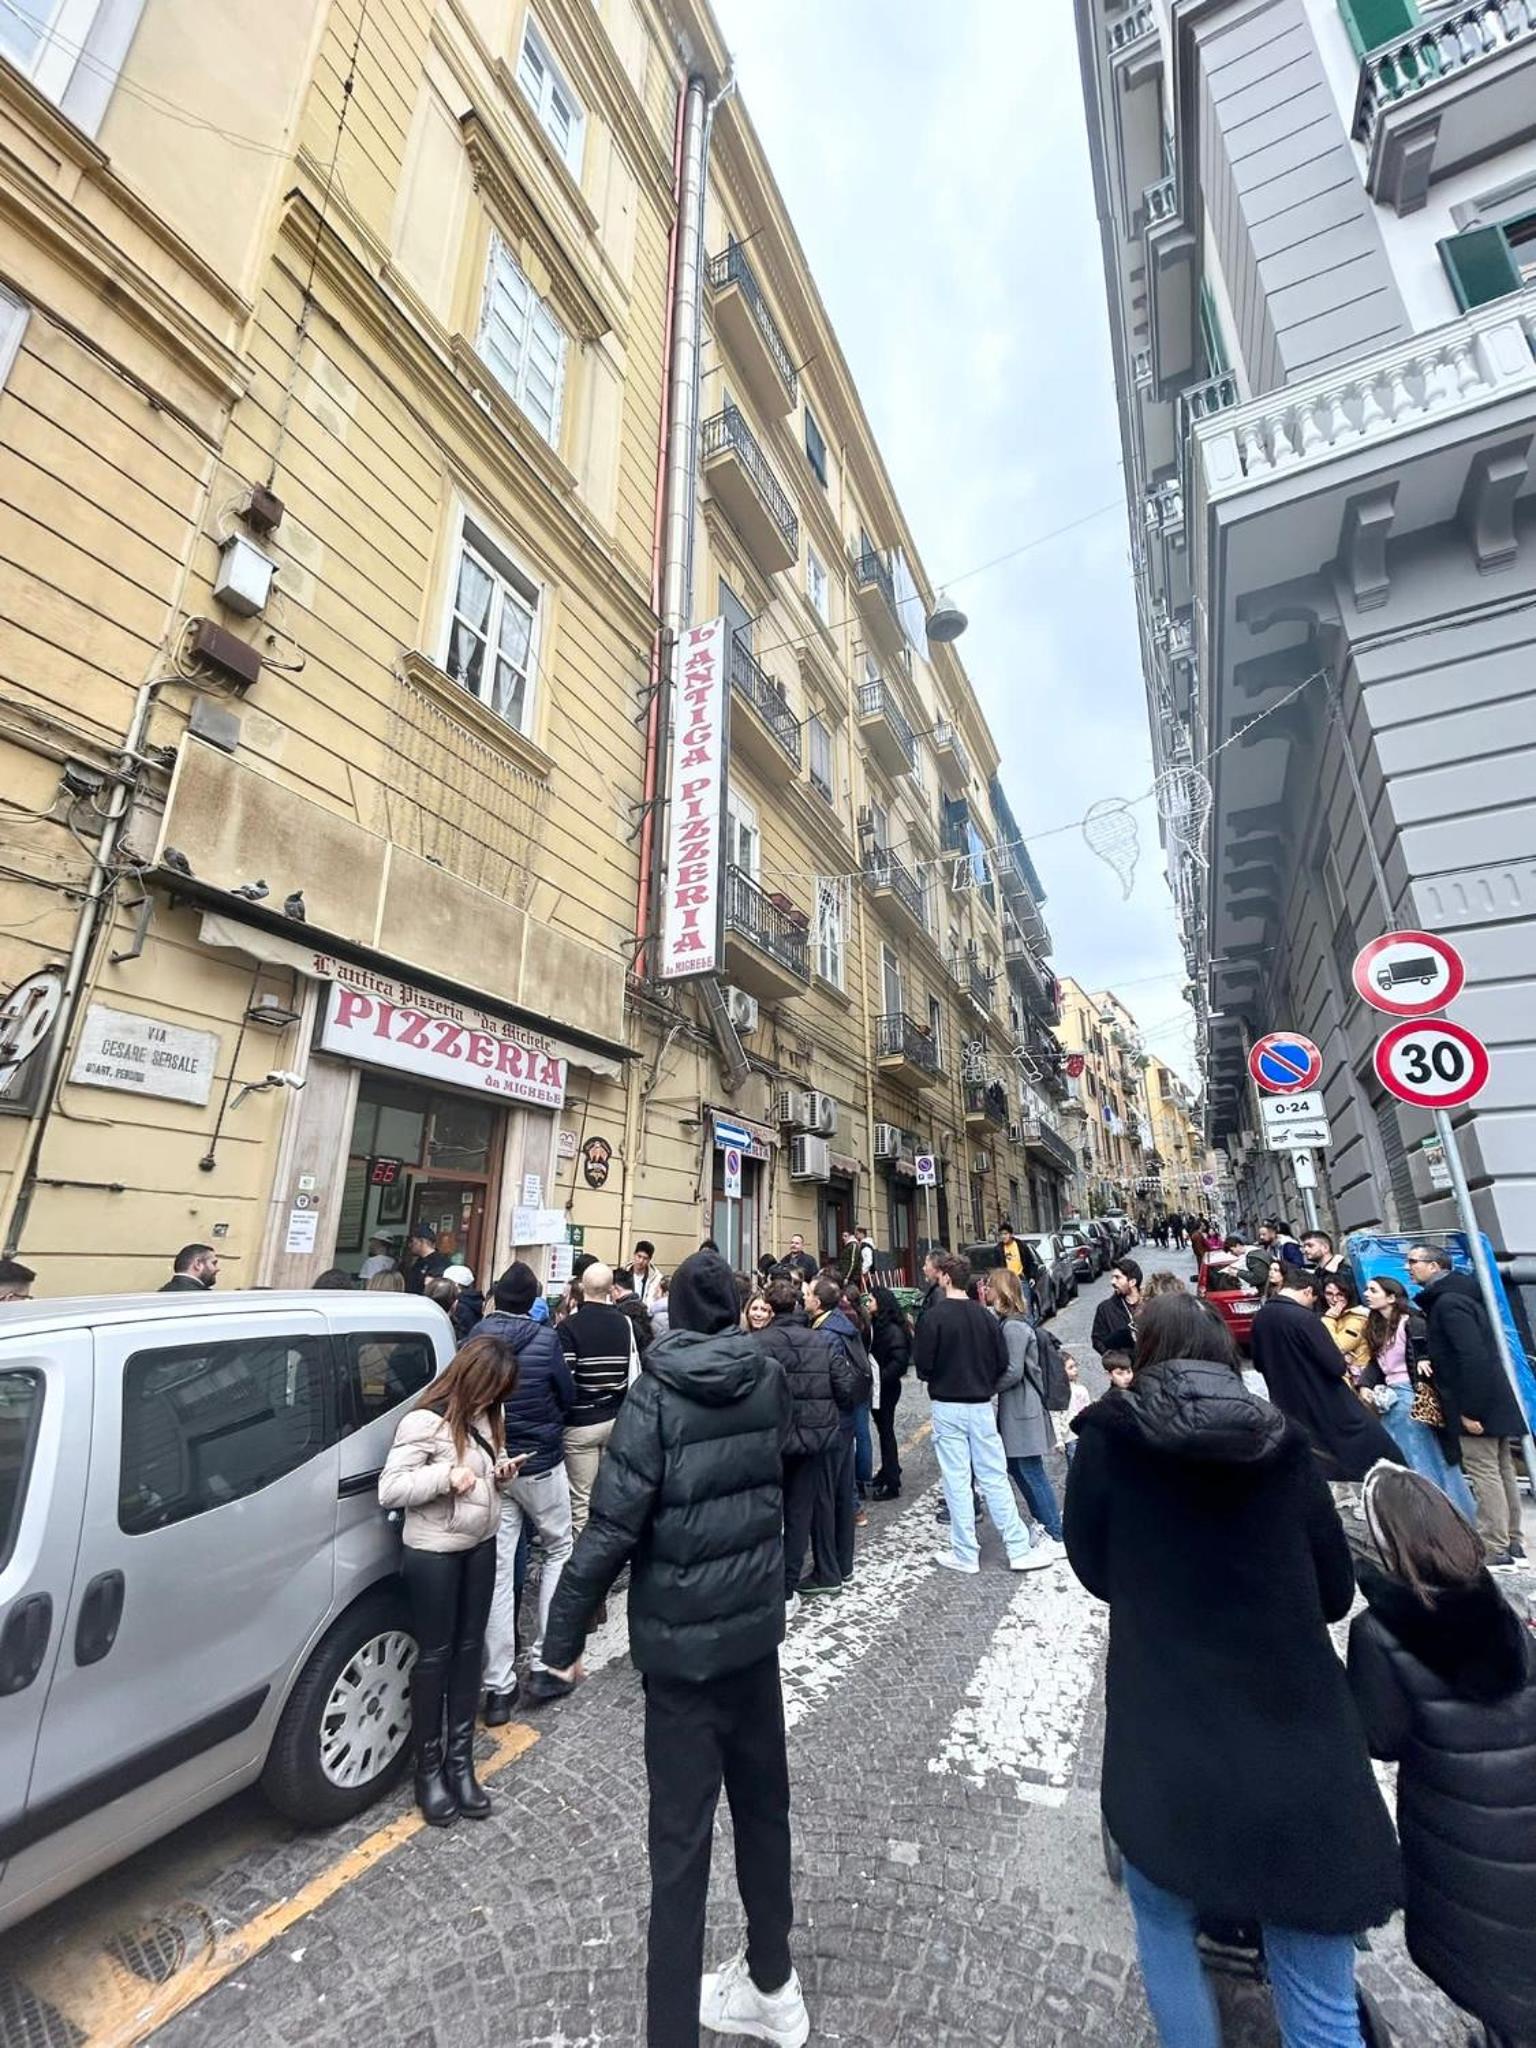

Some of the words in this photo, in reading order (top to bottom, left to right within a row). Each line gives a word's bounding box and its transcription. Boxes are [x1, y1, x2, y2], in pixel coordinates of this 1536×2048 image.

[673, 777, 711, 954] PIZZERIA
[313, 953, 393, 996] L'antica
[400, 983, 464, 1021] Pizzeria
[148, 1026, 167, 1042] VIA
[334, 988, 562, 1088] PIZZERIA
[101, 1039, 148, 1063] CESARE
[152, 1049, 199, 1074] SERSALE
[1401, 1041, 1464, 1084] 30
[1275, 1101, 1310, 1114] 0-24
